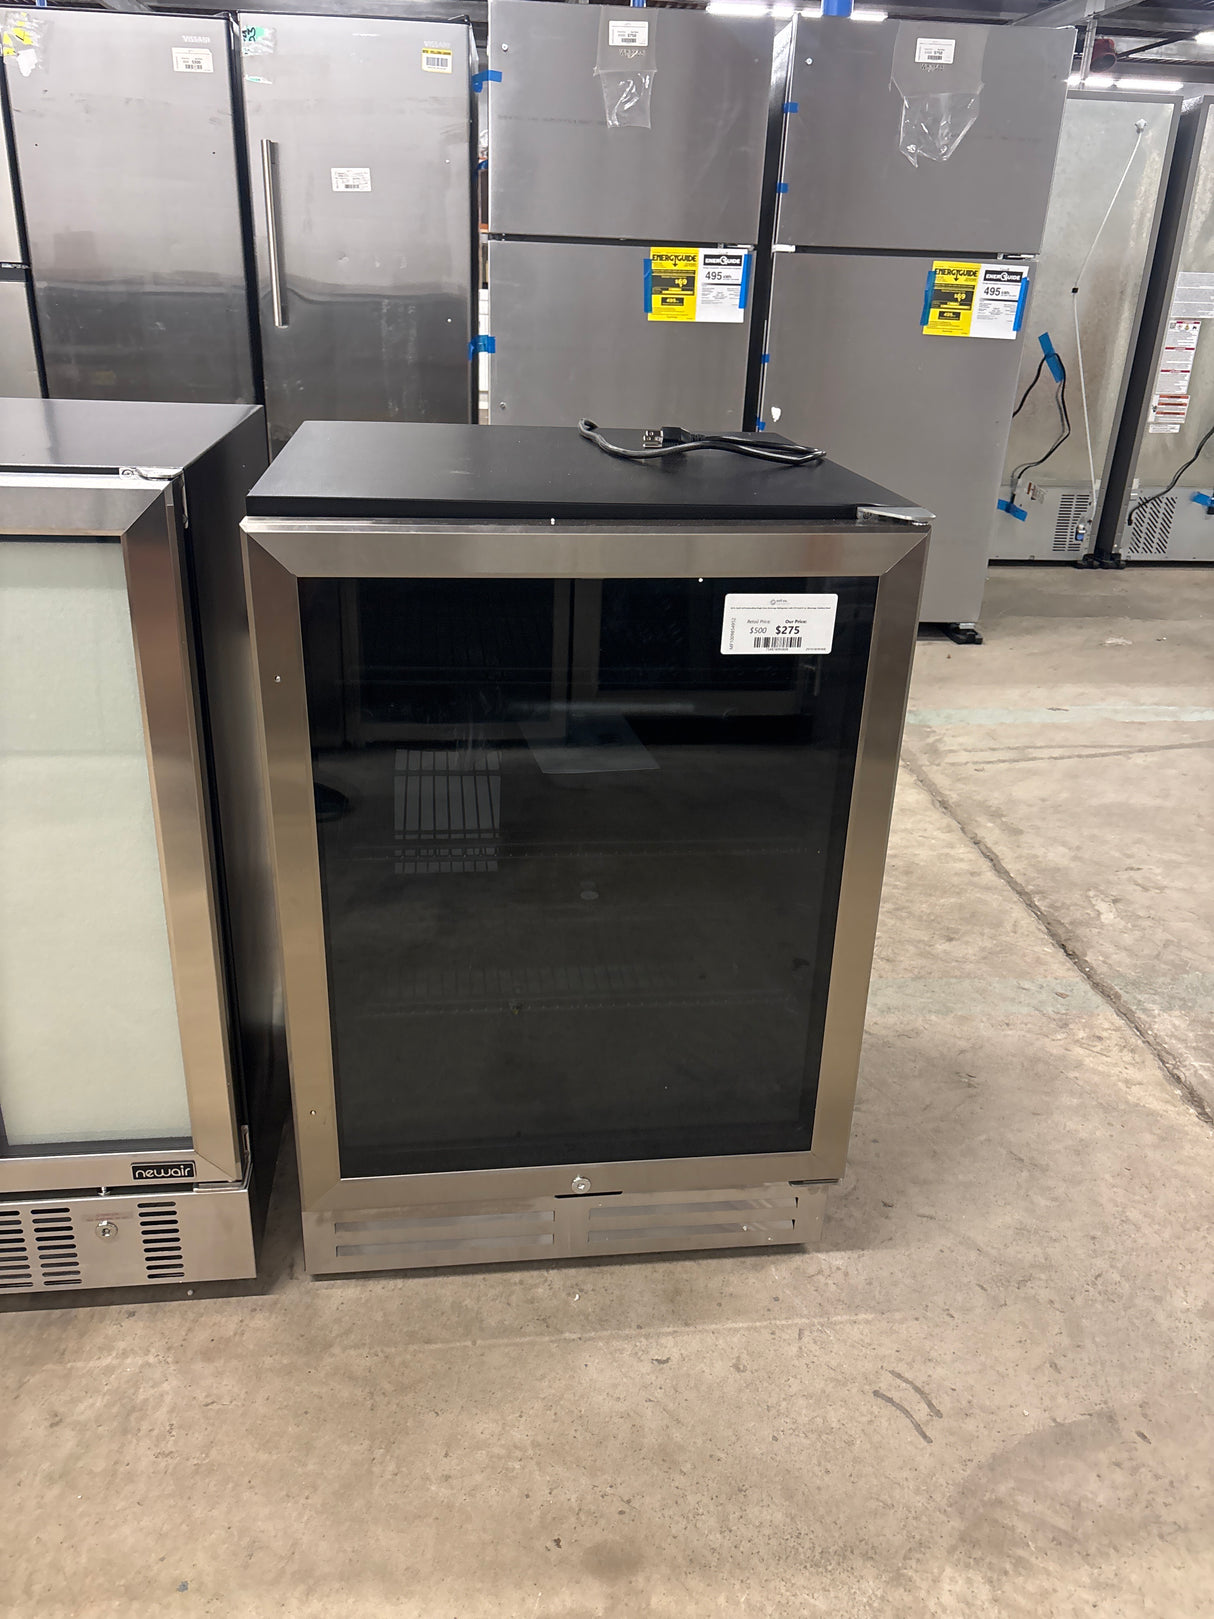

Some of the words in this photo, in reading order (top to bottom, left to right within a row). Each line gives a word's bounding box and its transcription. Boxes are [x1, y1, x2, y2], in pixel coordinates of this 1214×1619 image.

[705, 271, 722, 281] 495
[983, 286, 1001, 297] 495
[749, 626, 768, 635] $500
[775, 625, 800, 635] $275
[135, 1165, 191, 1178] newair
